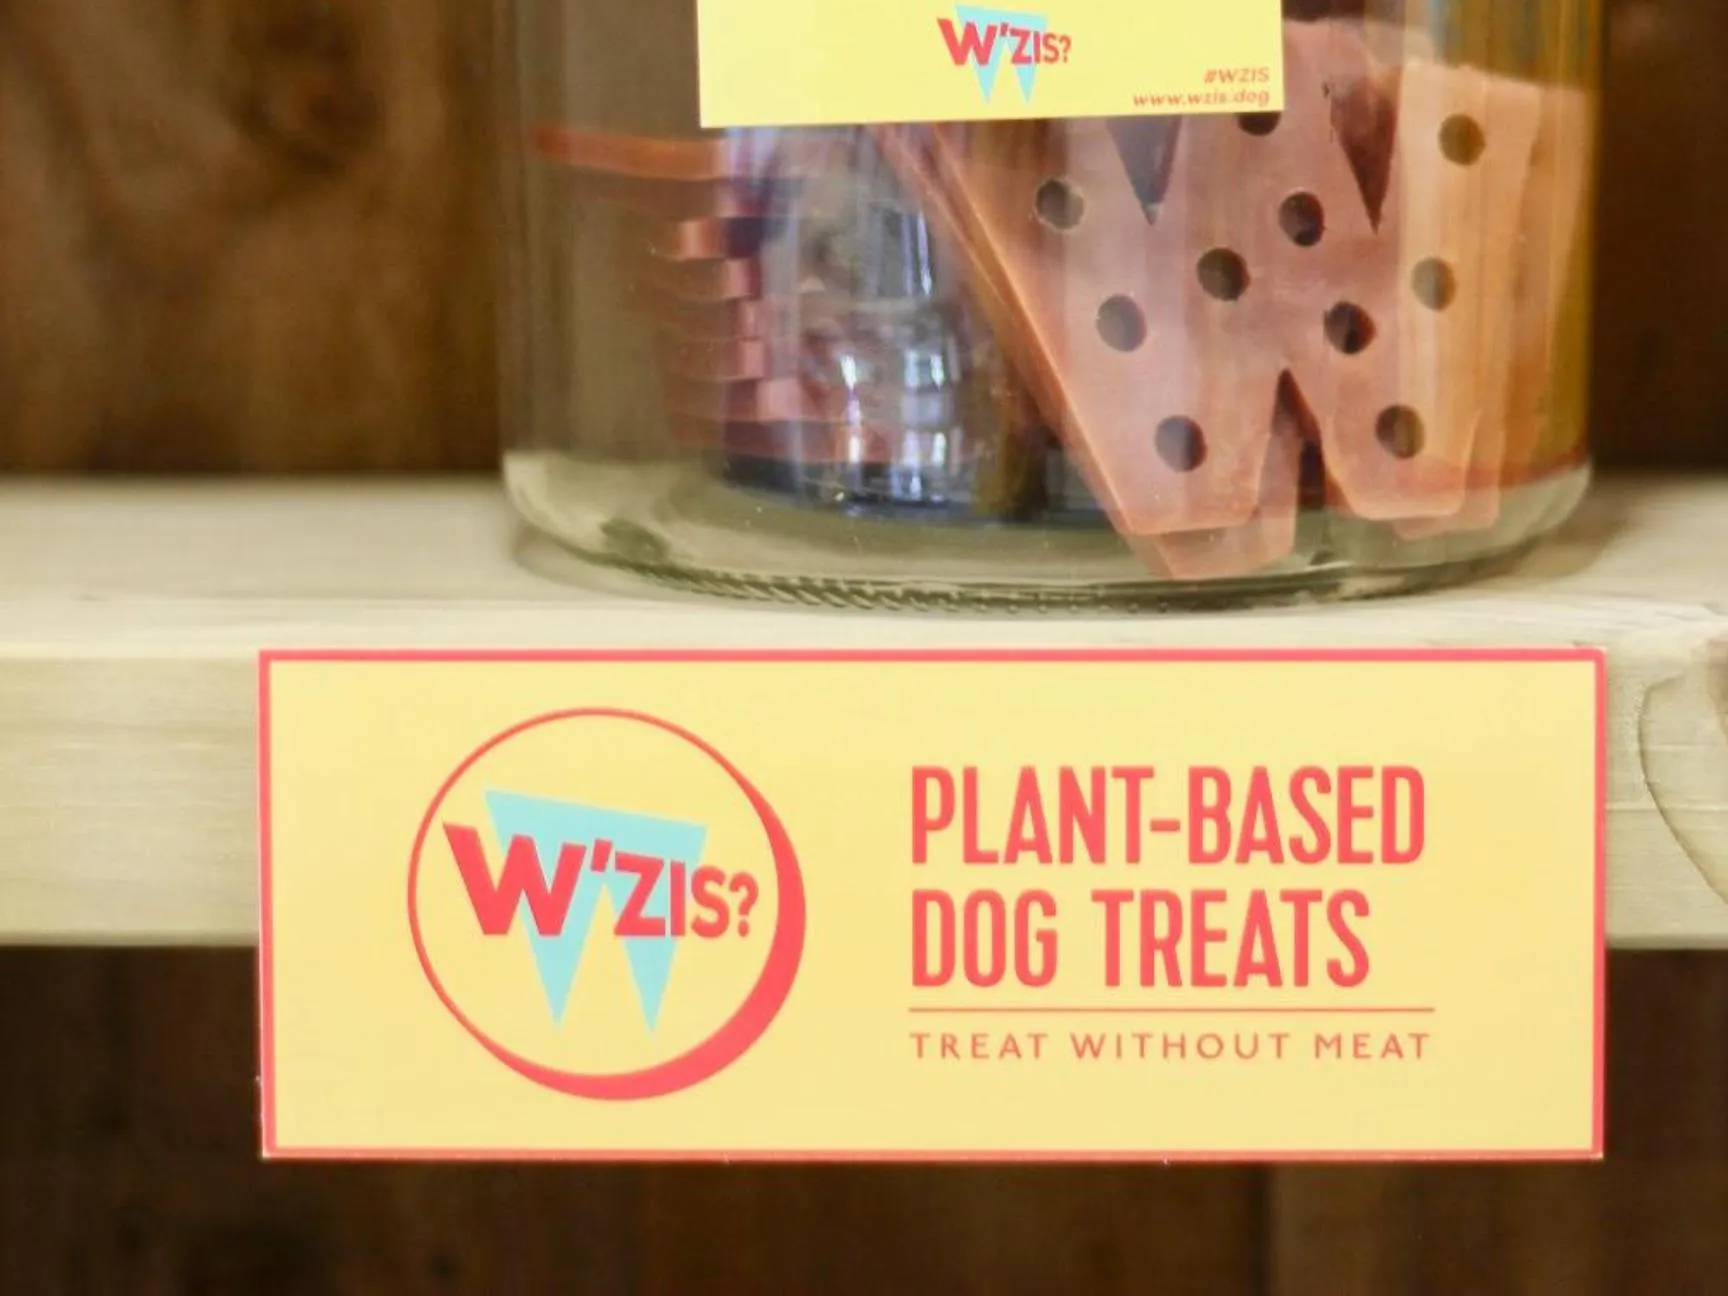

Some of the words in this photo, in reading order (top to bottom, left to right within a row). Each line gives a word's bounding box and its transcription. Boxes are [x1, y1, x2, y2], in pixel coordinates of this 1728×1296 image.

[1204, 68, 1269, 83] #WZIS
[1133, 89, 1270, 107] www.wzis.dog
[912, 766, 1424, 864] PLANT-BASED
[912, 890, 1057, 987] DOG
[1093, 890, 1369, 987] TREATS
[910, 1033, 1047, 1059] TREAT
[1070, 1033, 1289, 1060] WITHOUT
[1314, 1033, 1429, 1059] MEAT
